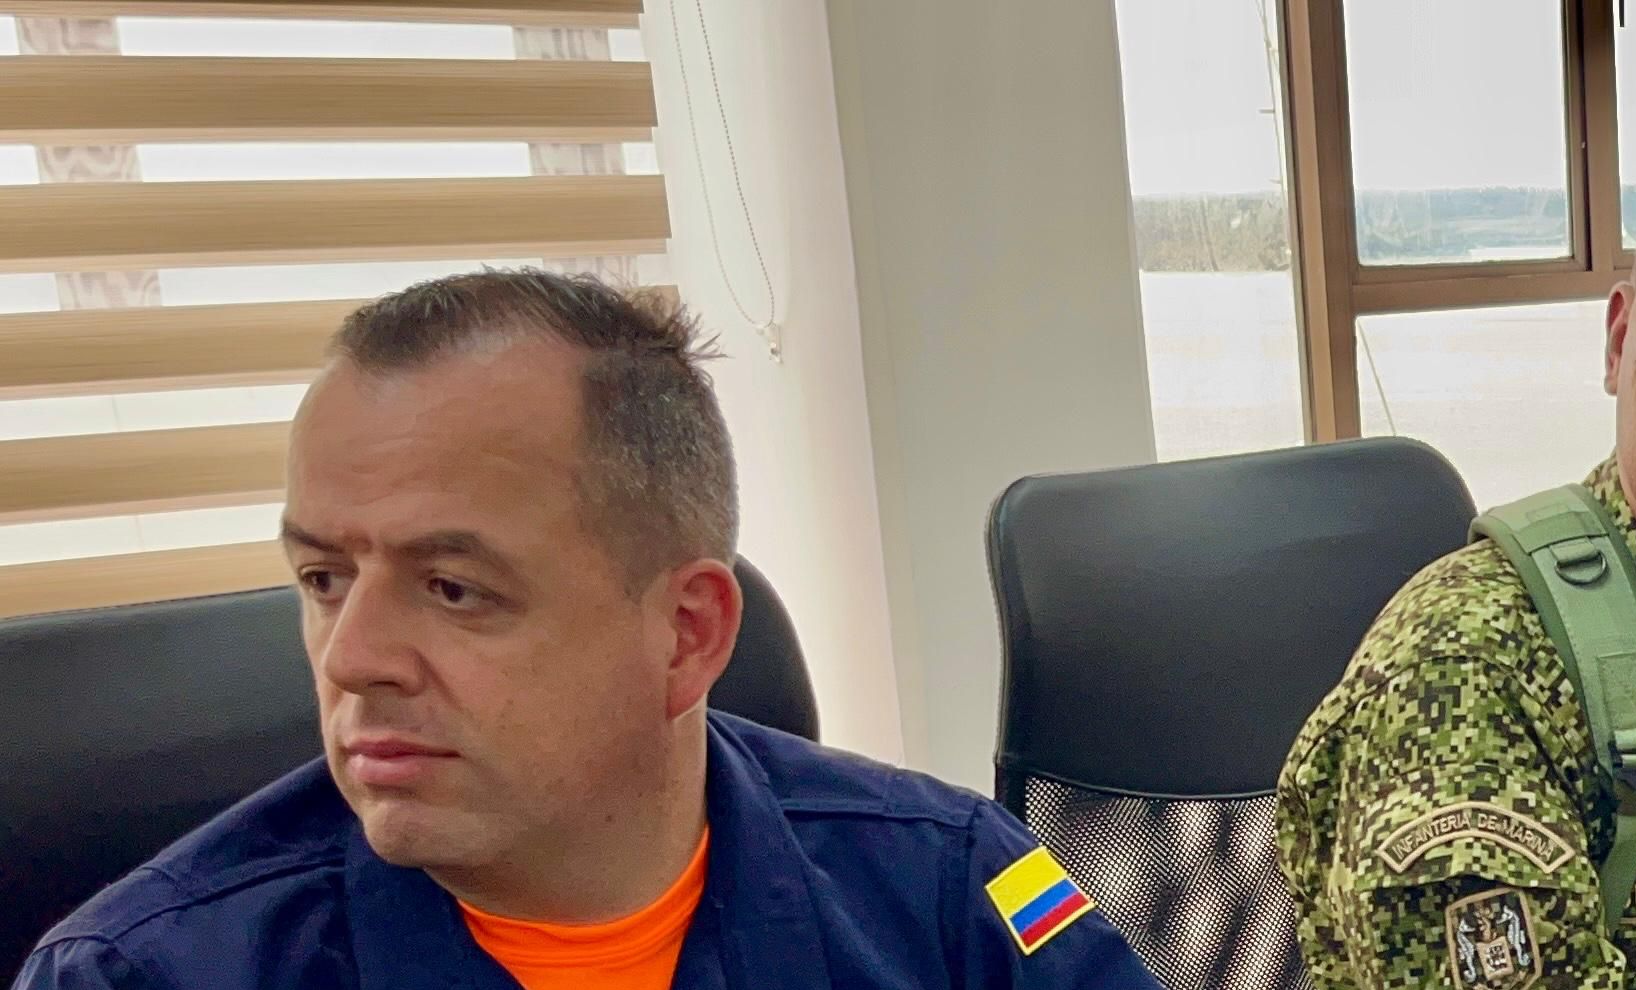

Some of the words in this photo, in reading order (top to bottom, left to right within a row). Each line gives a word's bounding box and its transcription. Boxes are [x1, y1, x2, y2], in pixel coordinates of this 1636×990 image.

[1391, 812, 1471, 860] INFANTERIA
[1477, 813, 1498, 832] DE
[1500, 817, 1555, 861] MARINA
